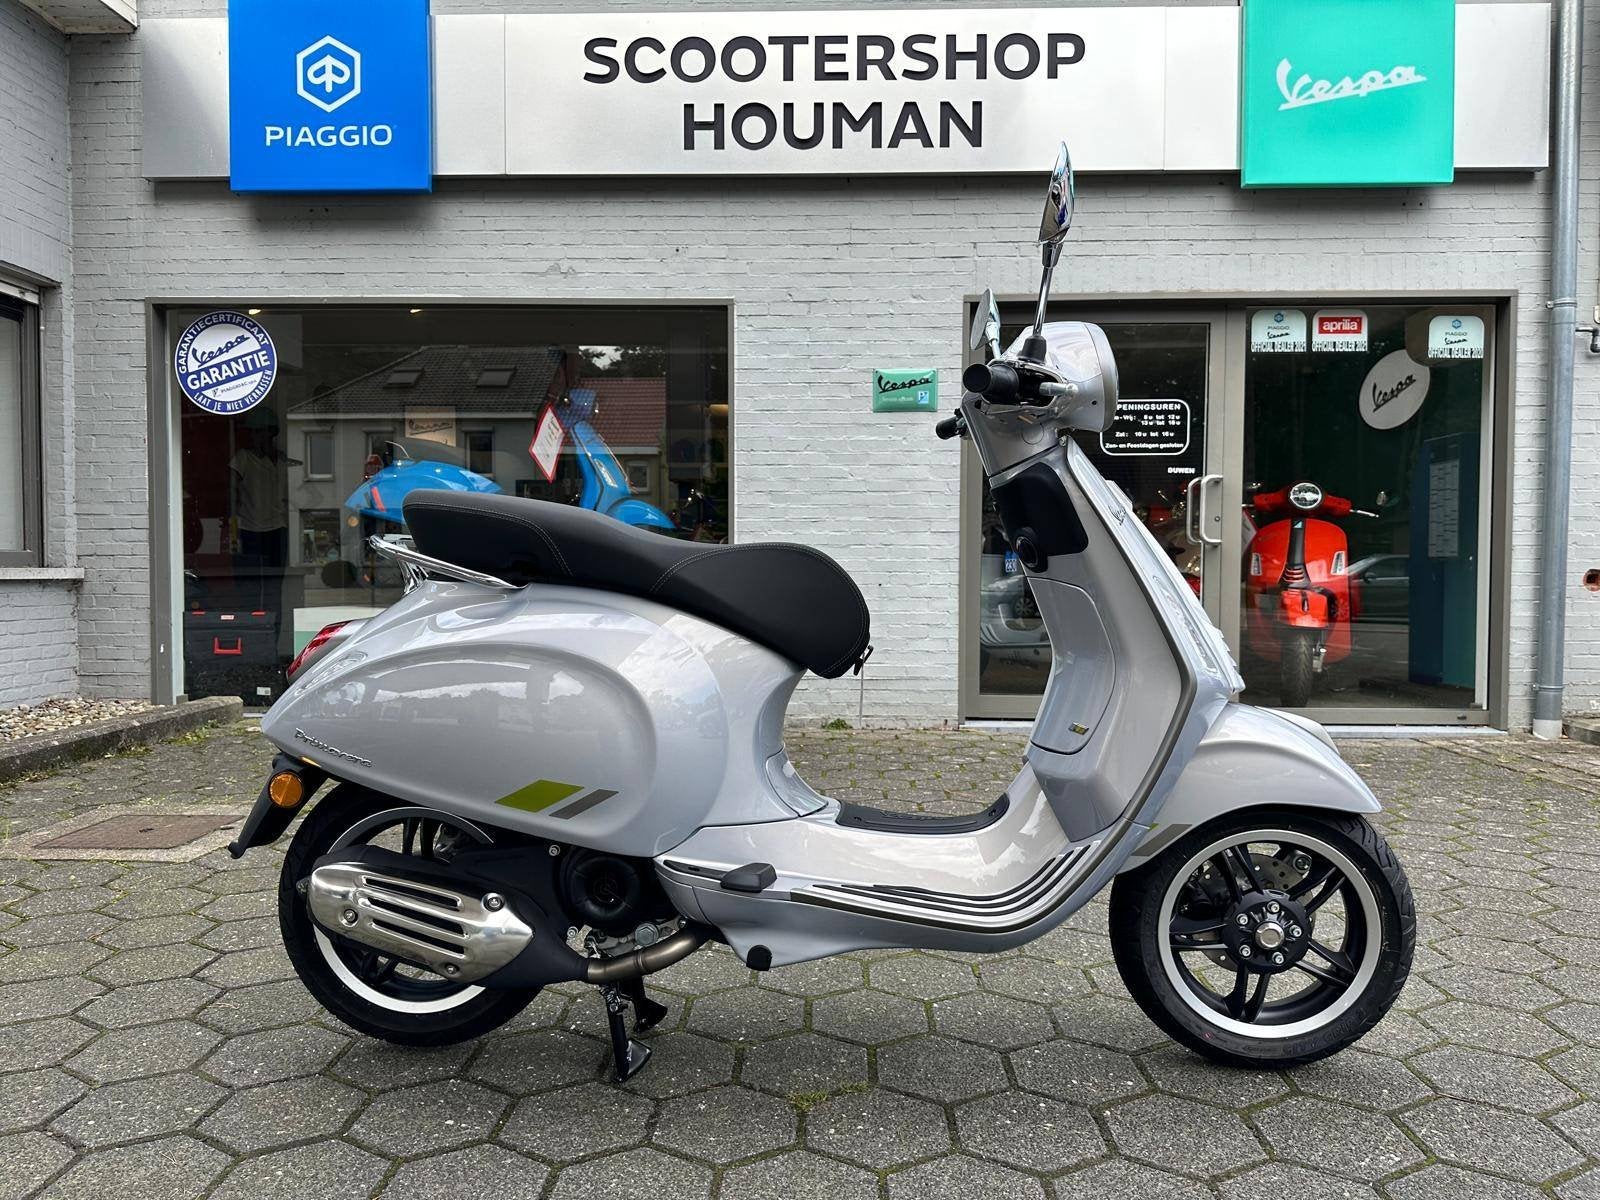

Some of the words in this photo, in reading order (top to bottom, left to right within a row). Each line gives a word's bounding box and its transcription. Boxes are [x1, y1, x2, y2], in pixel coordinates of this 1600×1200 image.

[583, 32, 1086, 84] SCOOTERSHOP
[1276, 57, 1428, 111] Vespa
[265, 124, 393, 147] PIAGGIO
[683, 101, 983, 151] HOUMAN
[178, 313, 269, 374] GARANTIECERTIFICAAT
[1322, 319, 1358, 332] aprilia
[191, 334, 250, 369] Vespa
[1251, 341, 1274, 352] OFFICIAL
[1274, 341, 1294, 352] DEALER
[1312, 341, 1335, 352] OFFICIAL
[1335, 341, 1355, 352] DEALER
[187, 350, 270, 390] GARANTIE
[877, 374, 933, 395] Vespa
[193, 392, 211, 406] LAAT
[213, 402, 222, 412] JE
[226, 400, 244, 411] NIET
[244, 369, 273, 405] VERRASSEN
[1116, 403, 1181, 411] PENINGSUREN
[1372, 374, 1416, 413] Vespa
